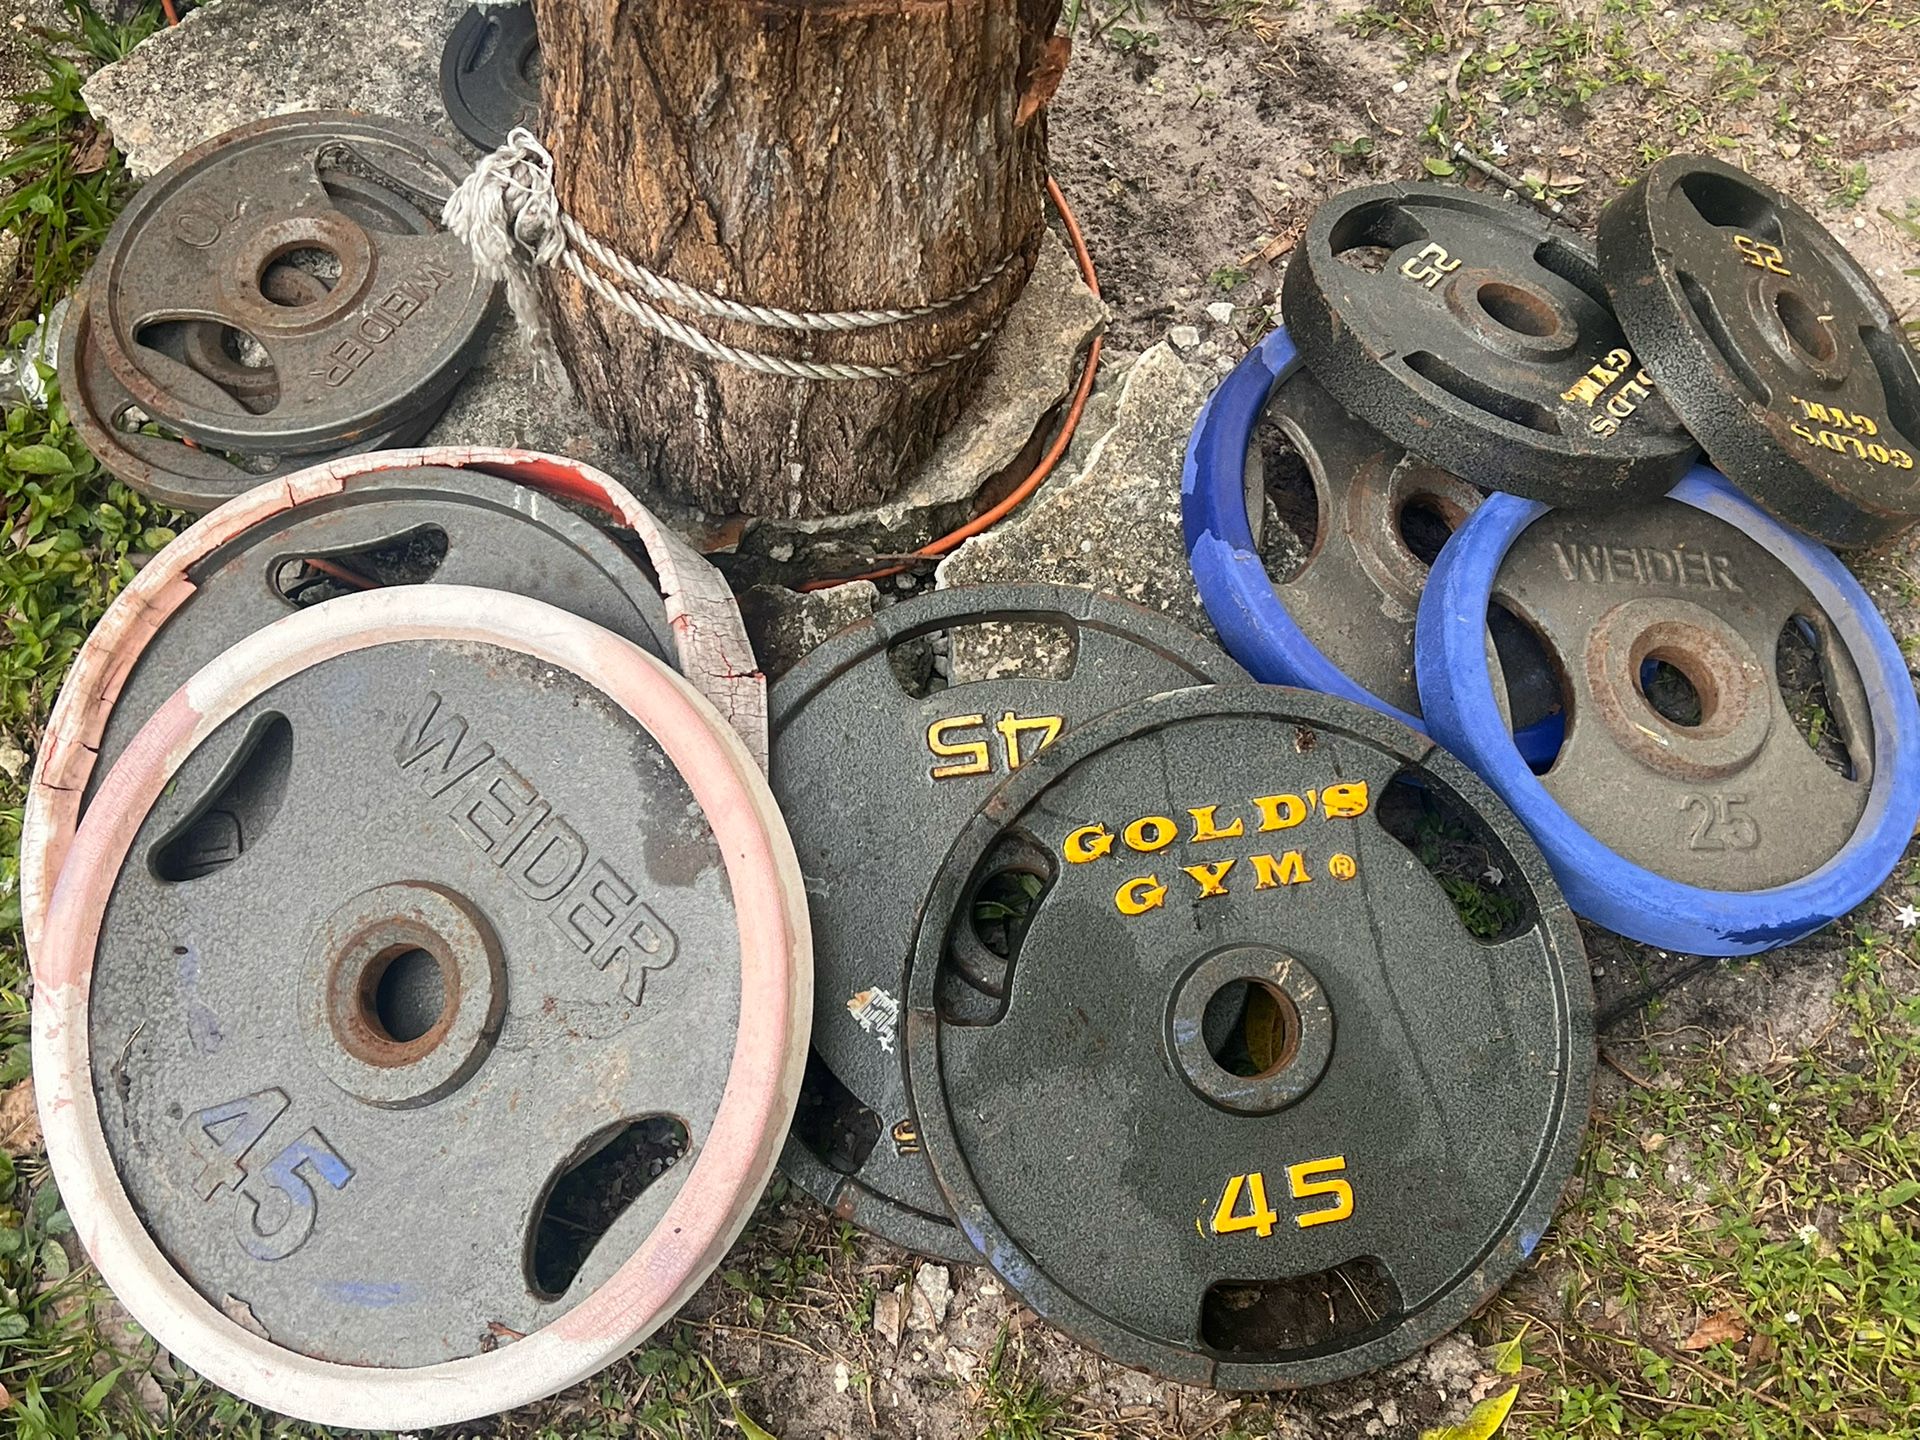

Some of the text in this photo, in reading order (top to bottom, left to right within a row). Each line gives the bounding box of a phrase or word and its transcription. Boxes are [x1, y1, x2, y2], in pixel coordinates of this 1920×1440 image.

[1399, 242, 1463, 290] 25
[1734, 234, 1792, 277] 25
[309, 260, 453, 388] WEIDER
[1552, 542, 1745, 594] WEIDER
[927, 710, 1064, 781] 45
[399, 690, 679, 1007] WEIDER
[1062, 779, 1370, 865] GOLD'S
[1678, 793, 1762, 852] 25
[181, 1086, 356, 1262] 45
[1210, 1154, 1356, 1238] 45
